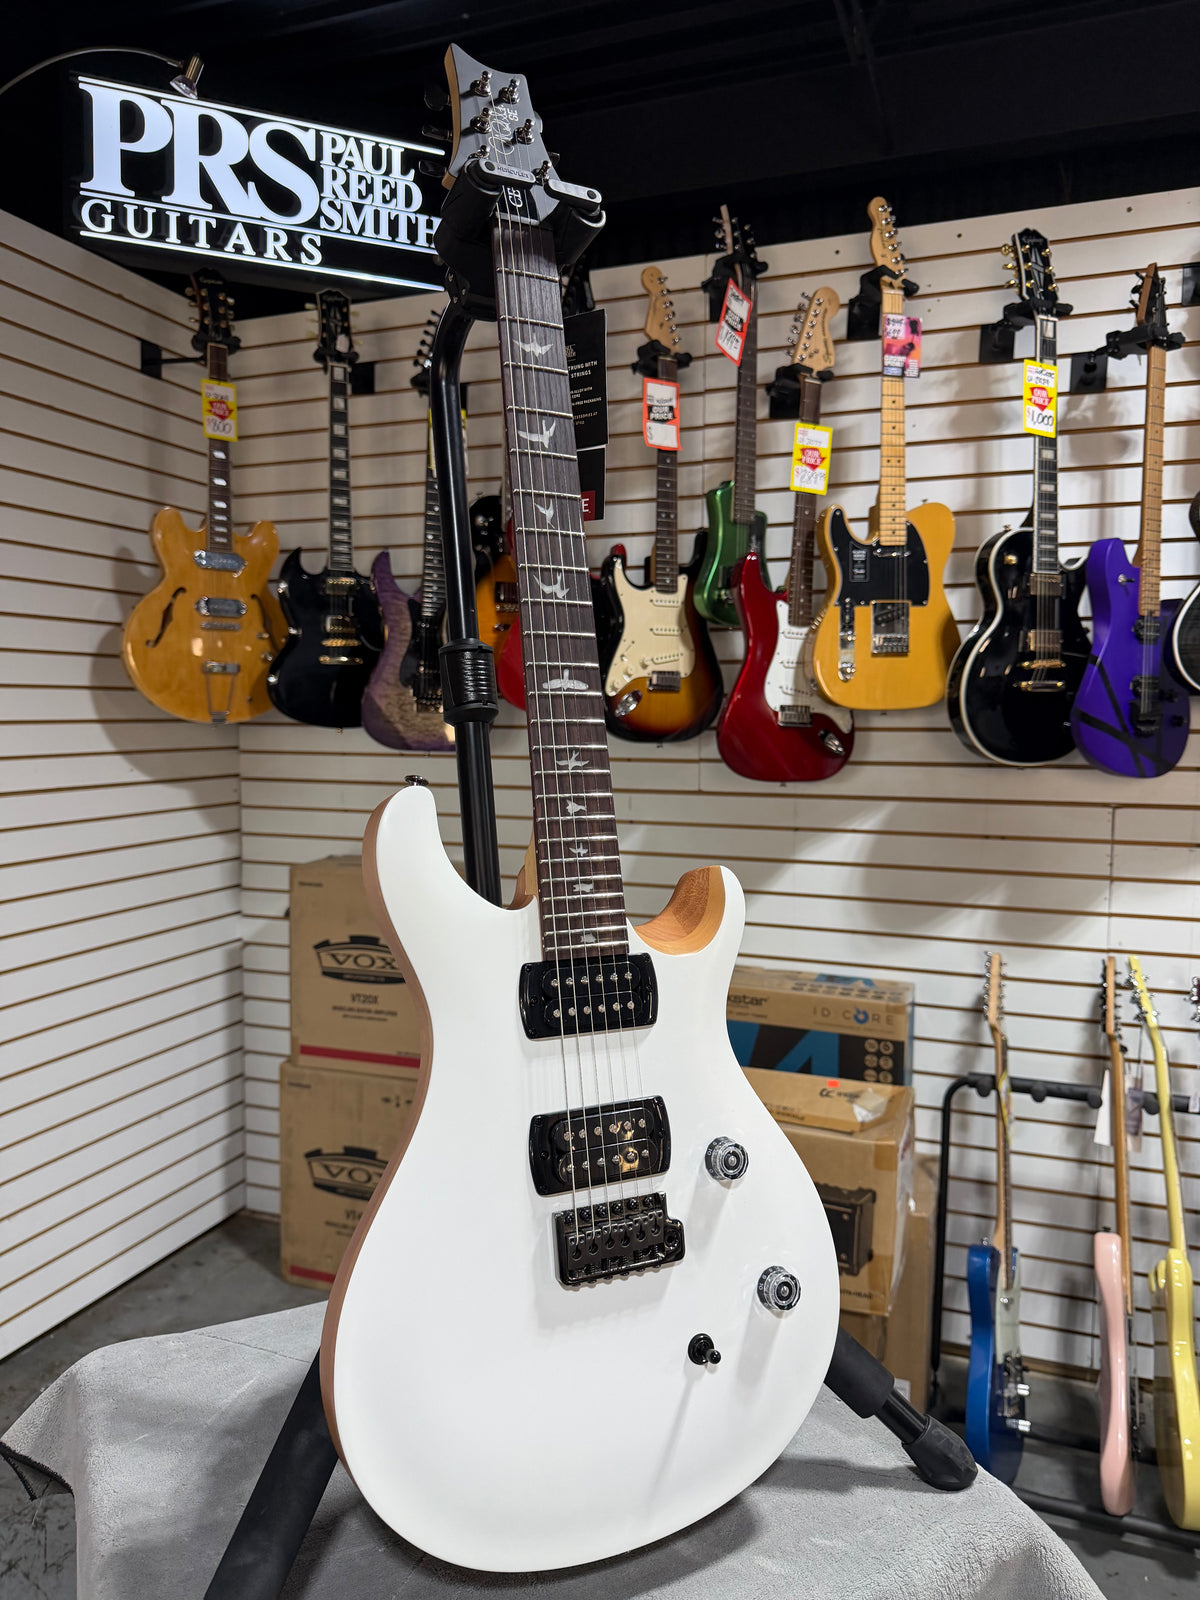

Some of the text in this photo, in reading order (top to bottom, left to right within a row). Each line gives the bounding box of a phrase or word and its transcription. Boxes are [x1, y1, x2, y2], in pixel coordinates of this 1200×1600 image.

[79, 82, 320, 225] PRS
[319, 131, 416, 182] PAUL
[320, 164, 423, 212] REED
[80, 198, 323, 266] GUITARS
[319, 197, 443, 248] SMITH
[326, 951, 398, 972] VOX
